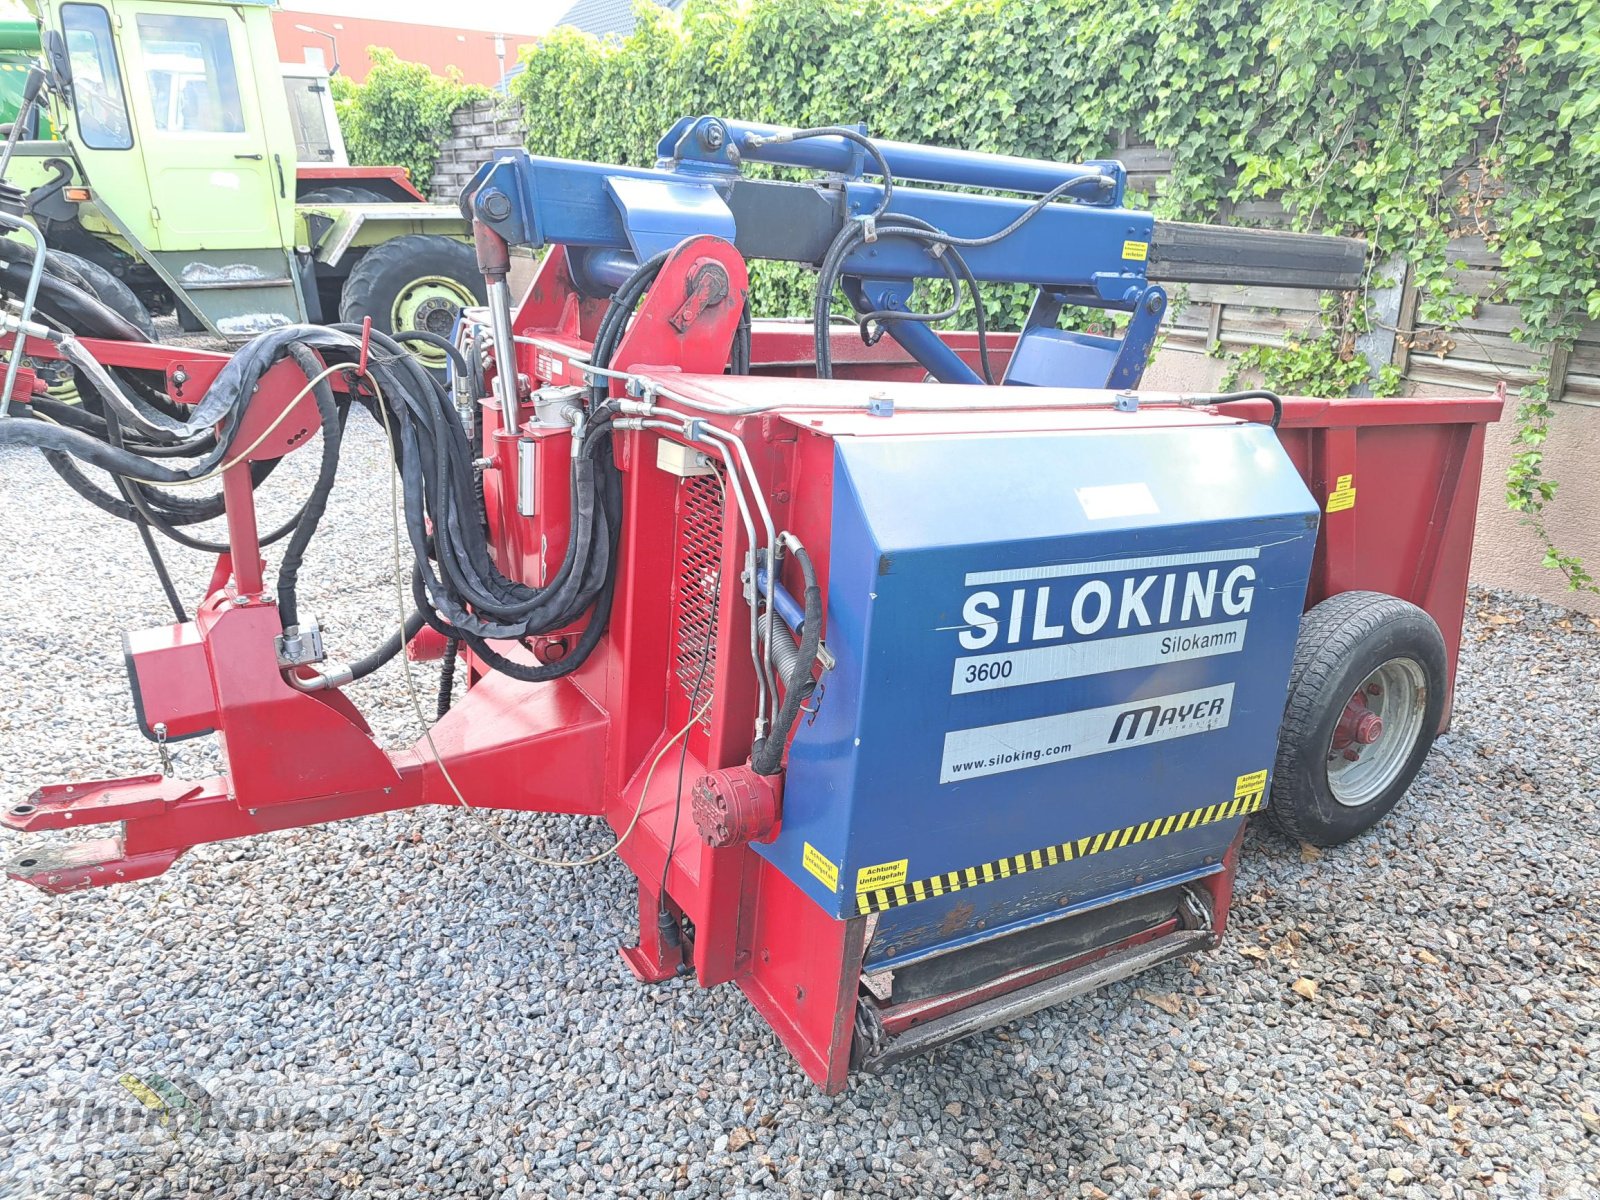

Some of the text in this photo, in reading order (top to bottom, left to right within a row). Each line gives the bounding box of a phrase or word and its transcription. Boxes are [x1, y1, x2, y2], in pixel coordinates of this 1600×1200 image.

[958, 564, 1256, 650] SILOKING
[1160, 631, 1237, 655] Silokamm
[965, 660, 1013, 684] 3600
[1107, 697, 1225, 745] MAYER
[952, 743, 1072, 773] www.siloking.com
[859, 870, 905, 886] Unfallgefahr
[866, 863, 901, 876] Achtung!
